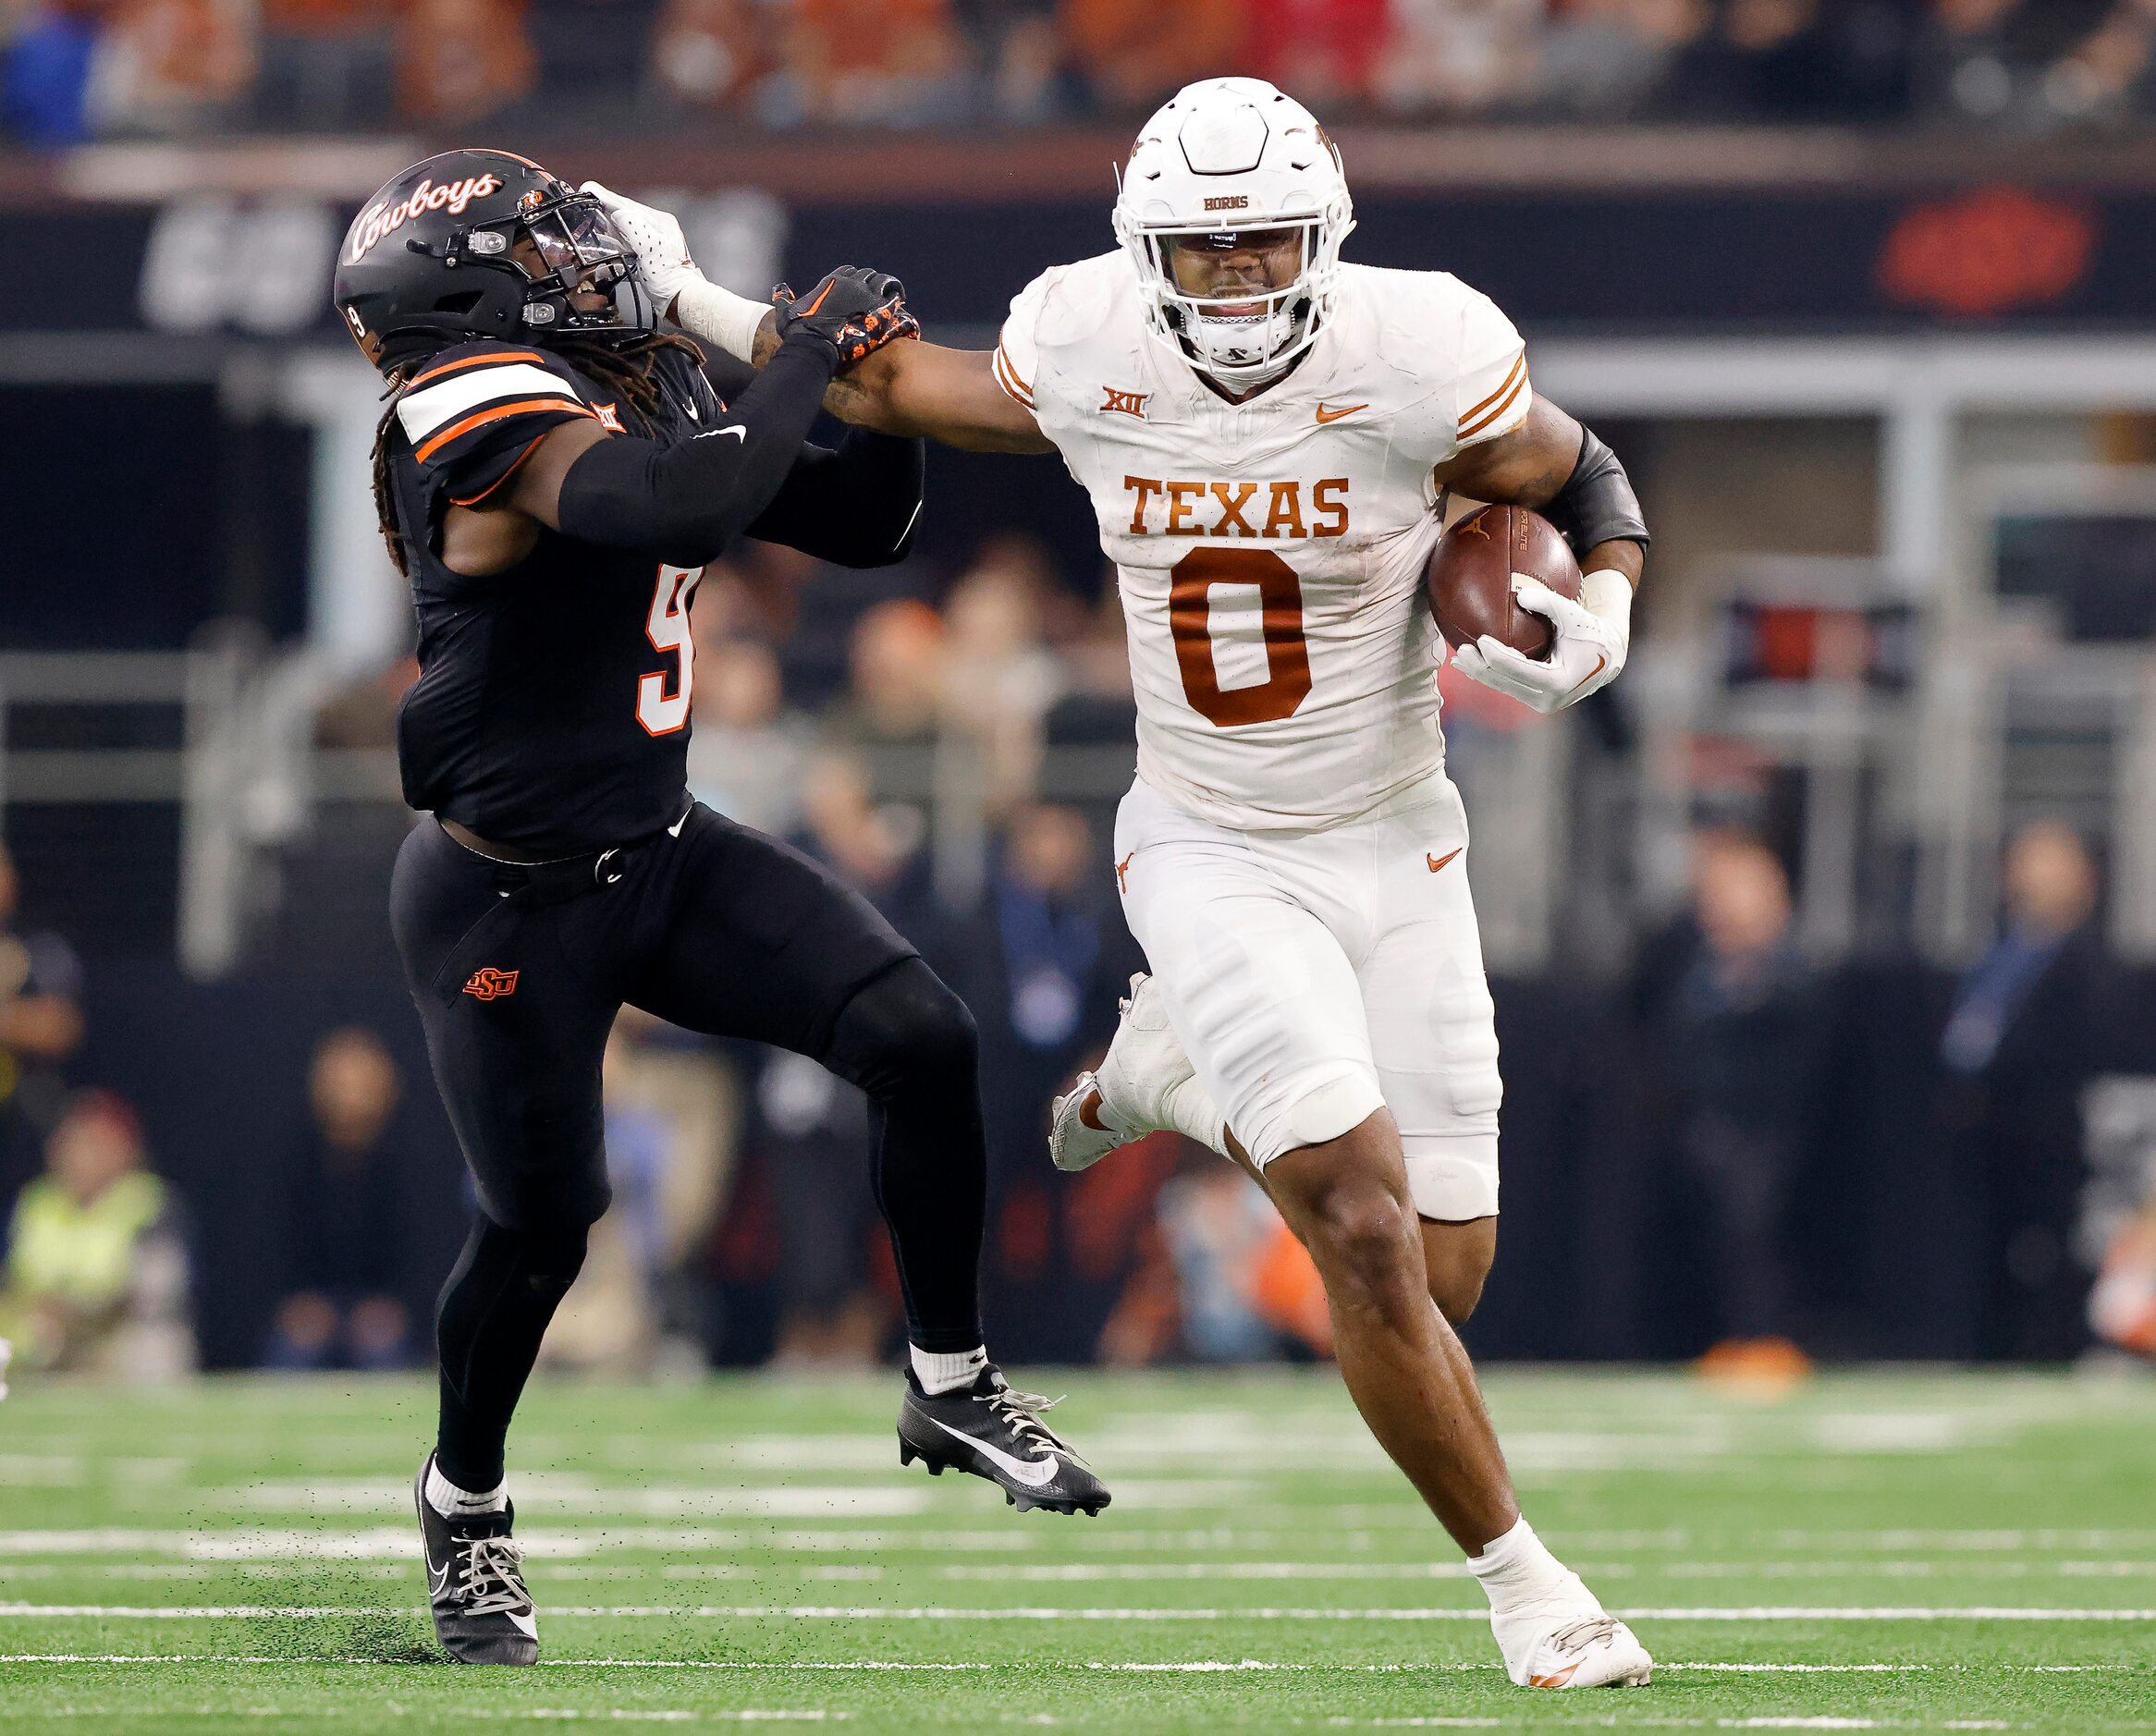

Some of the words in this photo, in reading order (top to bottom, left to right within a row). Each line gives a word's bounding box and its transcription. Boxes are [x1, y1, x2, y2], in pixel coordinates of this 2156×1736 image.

[350, 172, 506, 264] Cowboys
[1204, 195, 1249, 212] HORNS
[347, 305, 366, 338] 9
[1123, 474, 1350, 539] TEXAS
[635, 563, 705, 738] 9
[1169, 546, 1313, 727] 0
